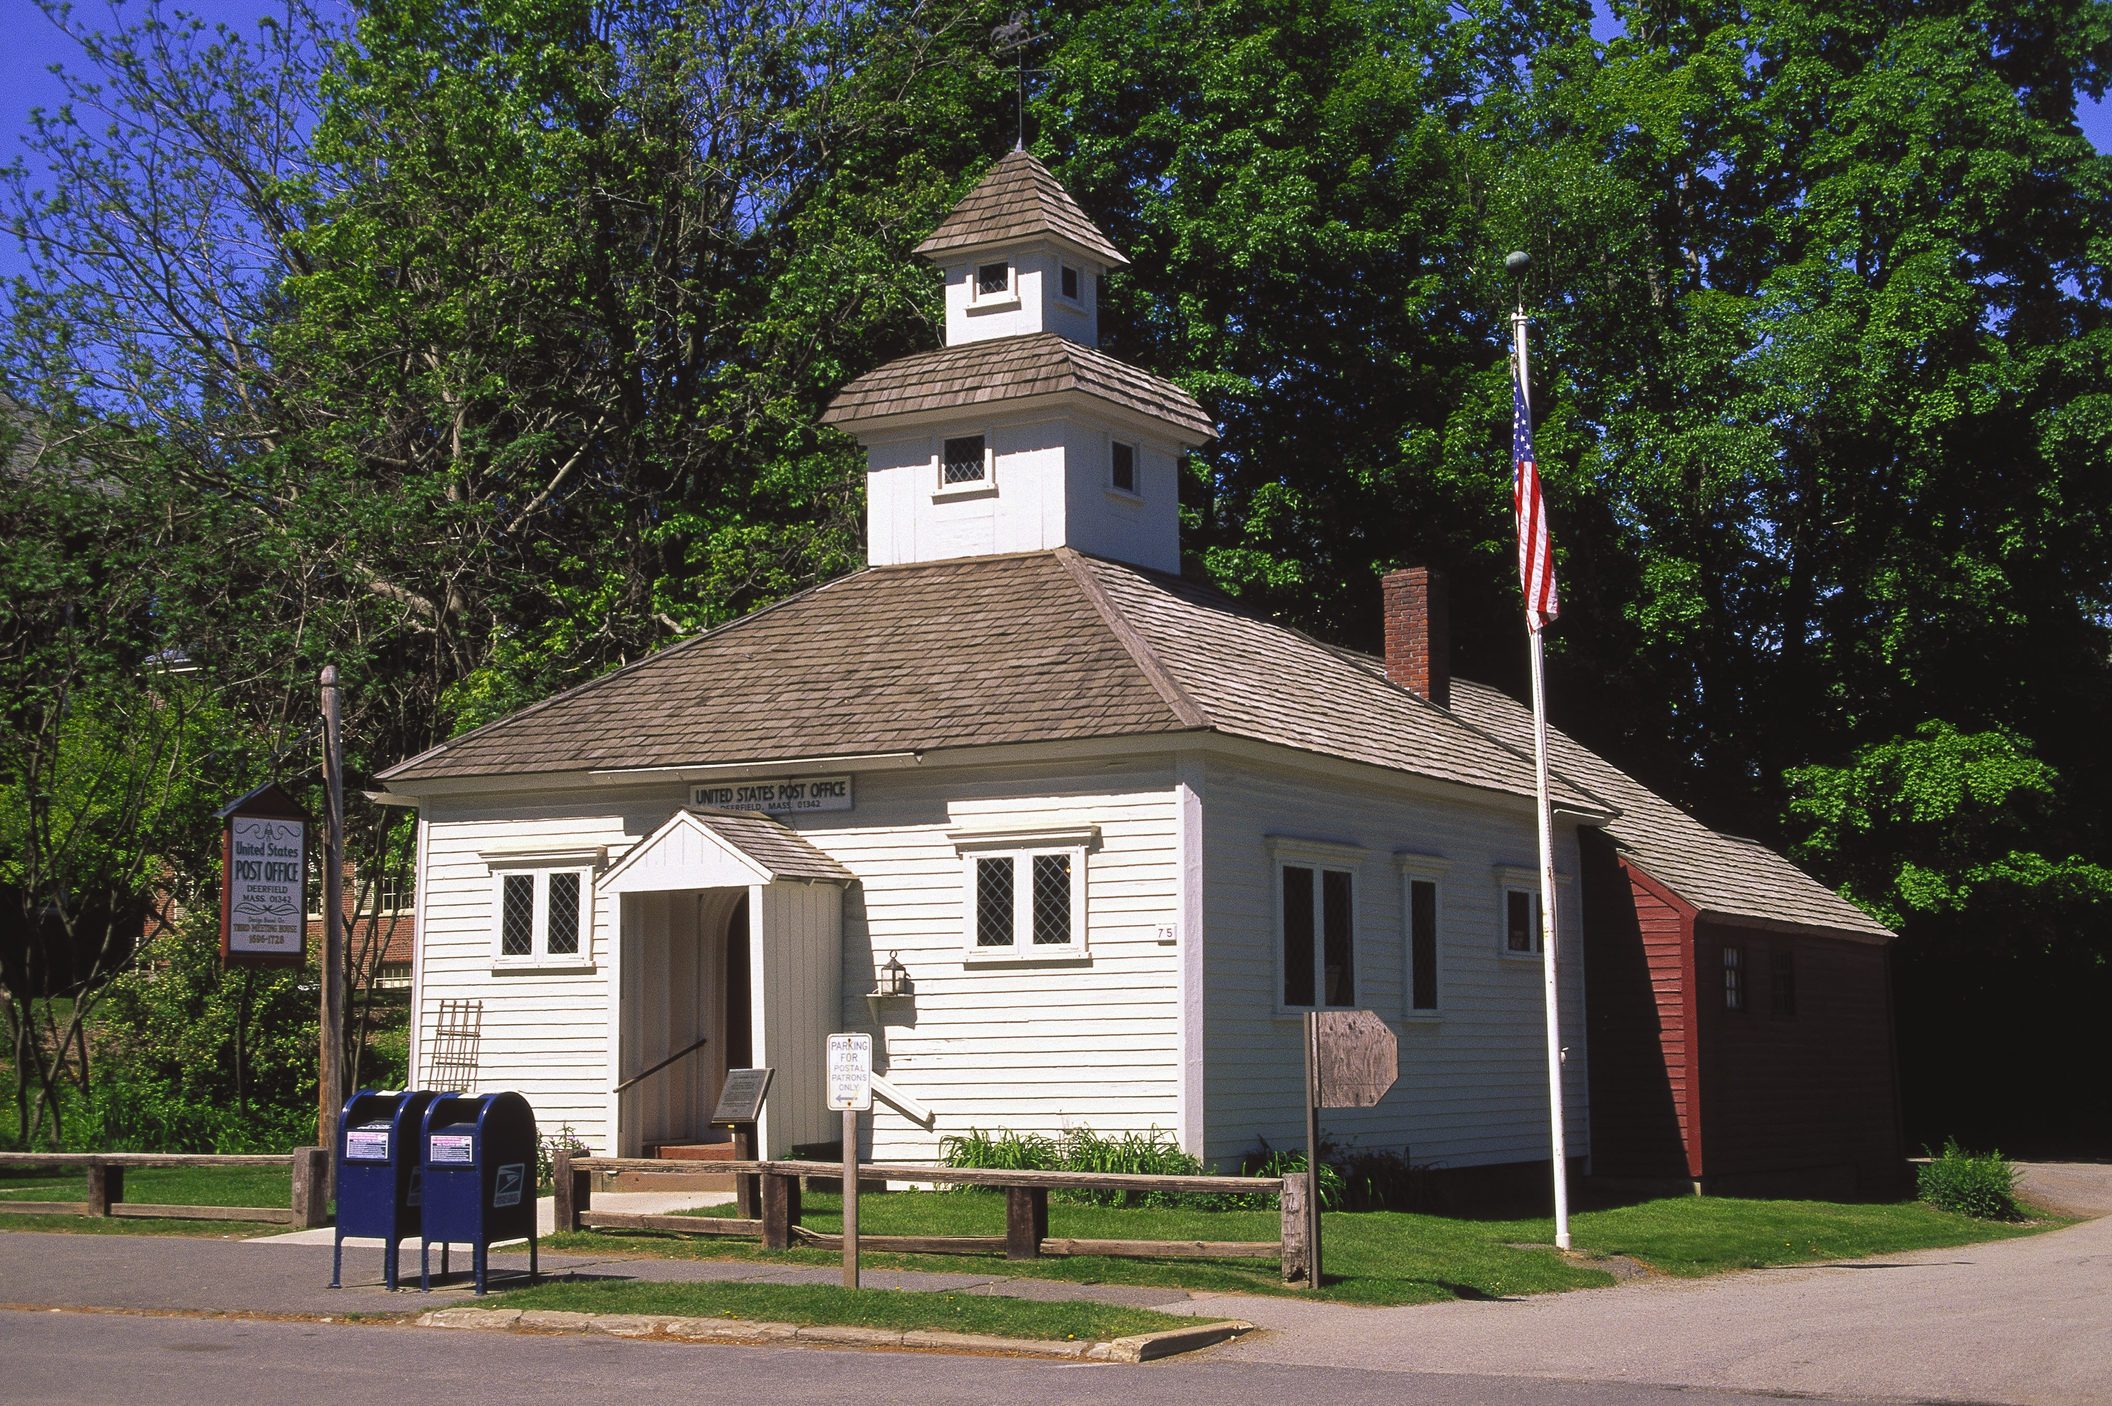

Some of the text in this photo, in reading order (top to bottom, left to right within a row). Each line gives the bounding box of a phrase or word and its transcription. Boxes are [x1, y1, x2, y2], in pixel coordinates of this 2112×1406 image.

[695, 780, 846, 804] UNITED STATES POST OFFICE
[797, 799, 821, 809] 01342
[235, 840, 299, 858] United States
[234, 860, 299, 882] POST OFFICE
[246, 884, 288, 894] DEERFIELD
[269, 895, 292, 904] 01342
[1158, 927, 1173, 938] 75
[831, 1041, 868, 1051] PARKING
[840, 1052, 858, 1062] FOR
[834, 1064, 865, 1072] POSTAL
